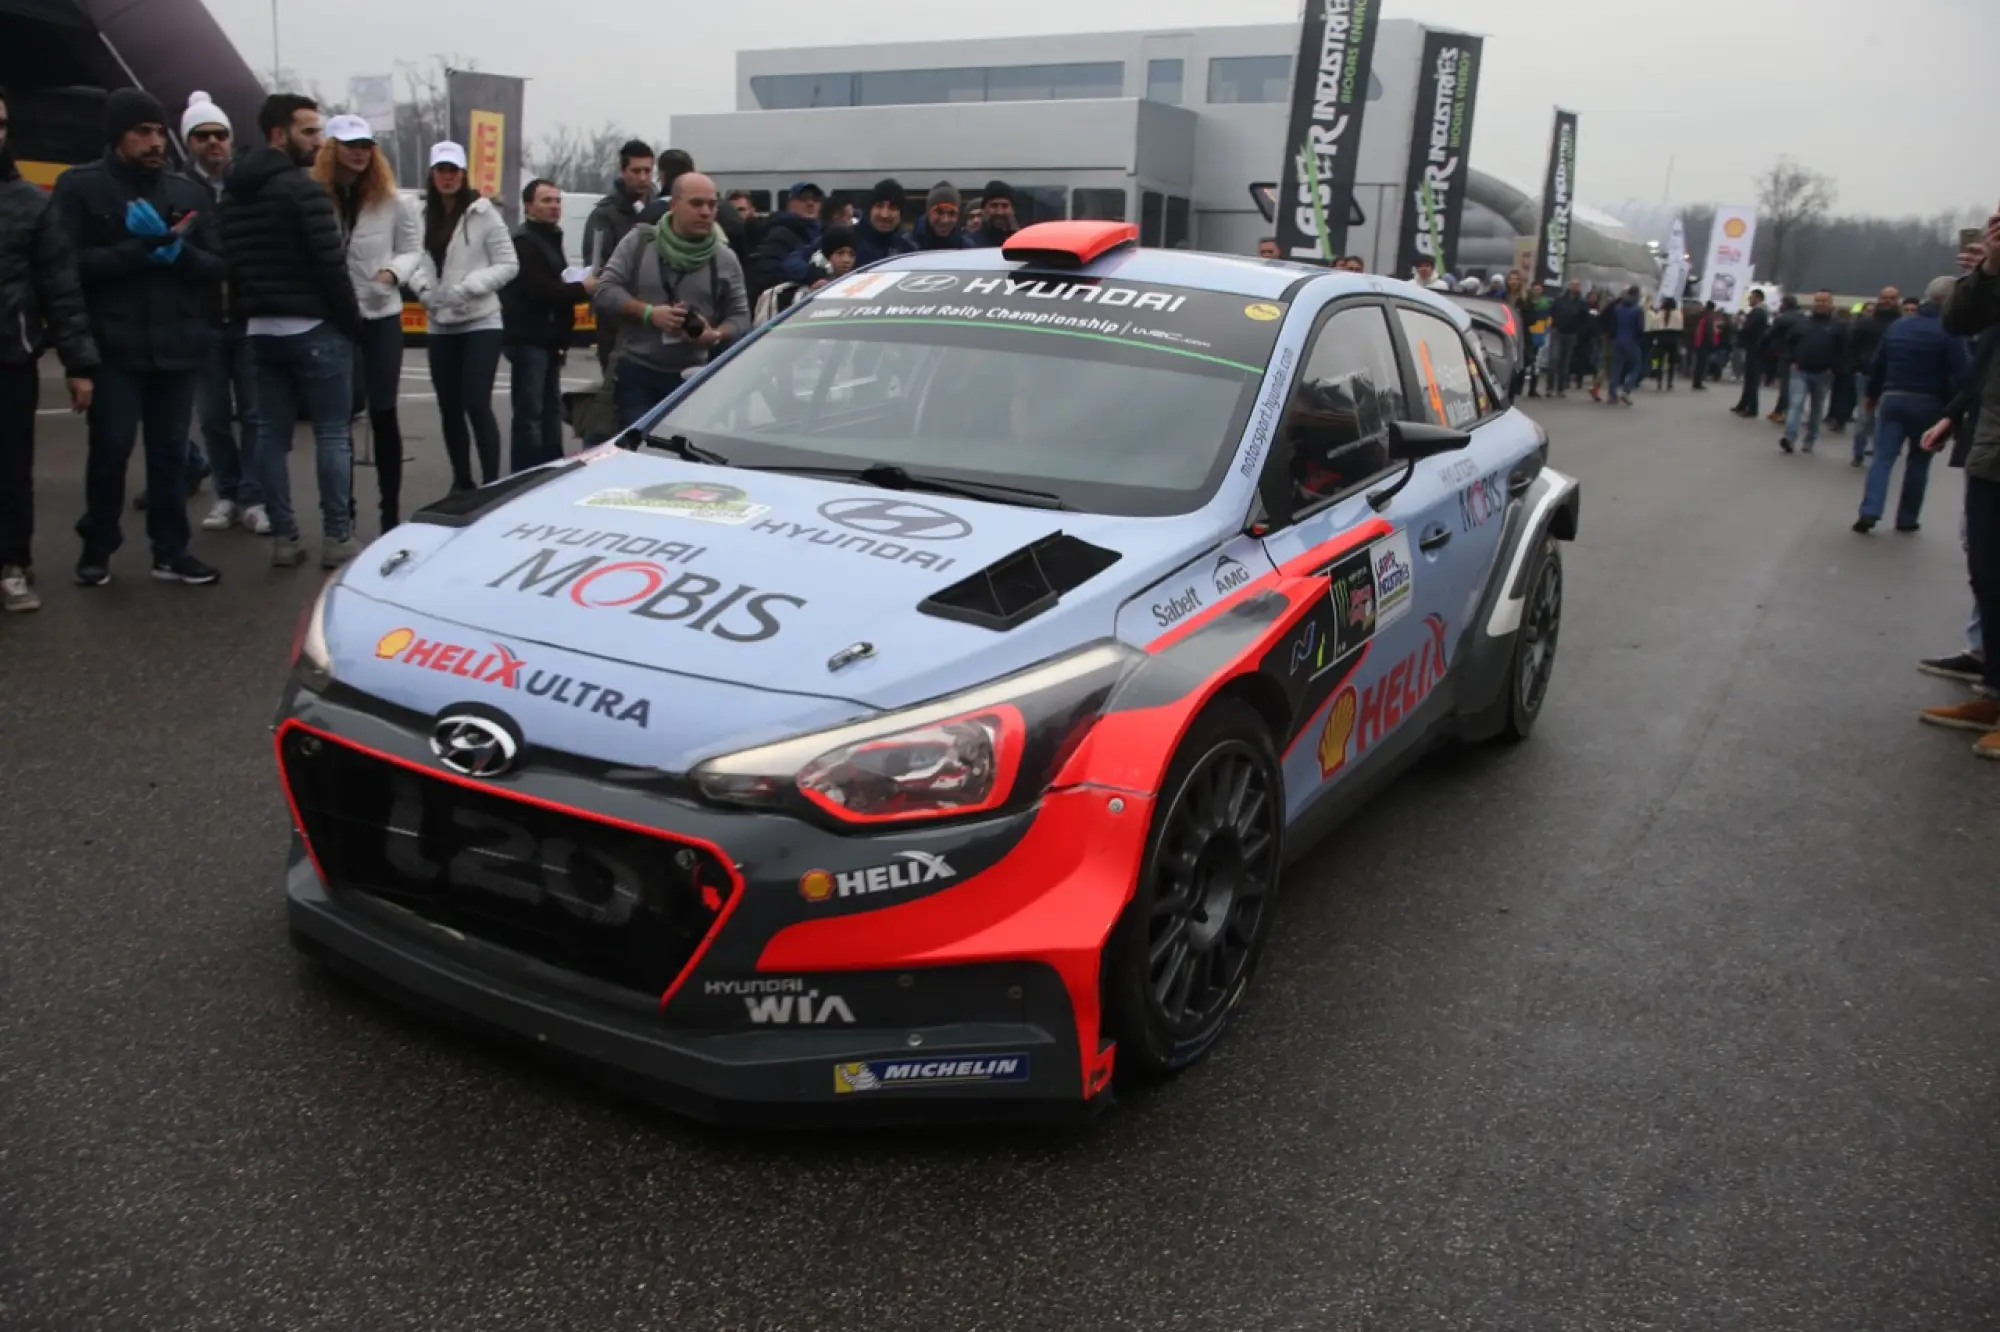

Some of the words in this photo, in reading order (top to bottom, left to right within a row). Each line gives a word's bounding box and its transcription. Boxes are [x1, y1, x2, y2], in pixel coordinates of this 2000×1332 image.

[1414, 156, 1459, 257] ASER
[962, 277, 1187, 312] HYUNDAI
[886, 304, 935, 316] World
[937, 305, 983, 318] Rally
[986, 307, 1119, 334] Championship
[1459, 470, 1501, 533] MOBIS
[501, 523, 708, 564] HYUNDAI
[750, 519, 956, 572] HYUNDAI
[485, 548, 807, 642] MOBIS
[1215, 568, 1250, 596] AMG
[1152, 586, 1203, 627] Sabelt
[402, 639, 528, 690] HELIX
[525, 669, 652, 729] ULTRA
[1356, 612, 1447, 753] HELIX
[836, 850, 957, 898] HELIX
[705, 978, 804, 994] HYUNDAI
[744, 989, 856, 1023] WIA
[884, 1059, 1019, 1080] MICHELIN
